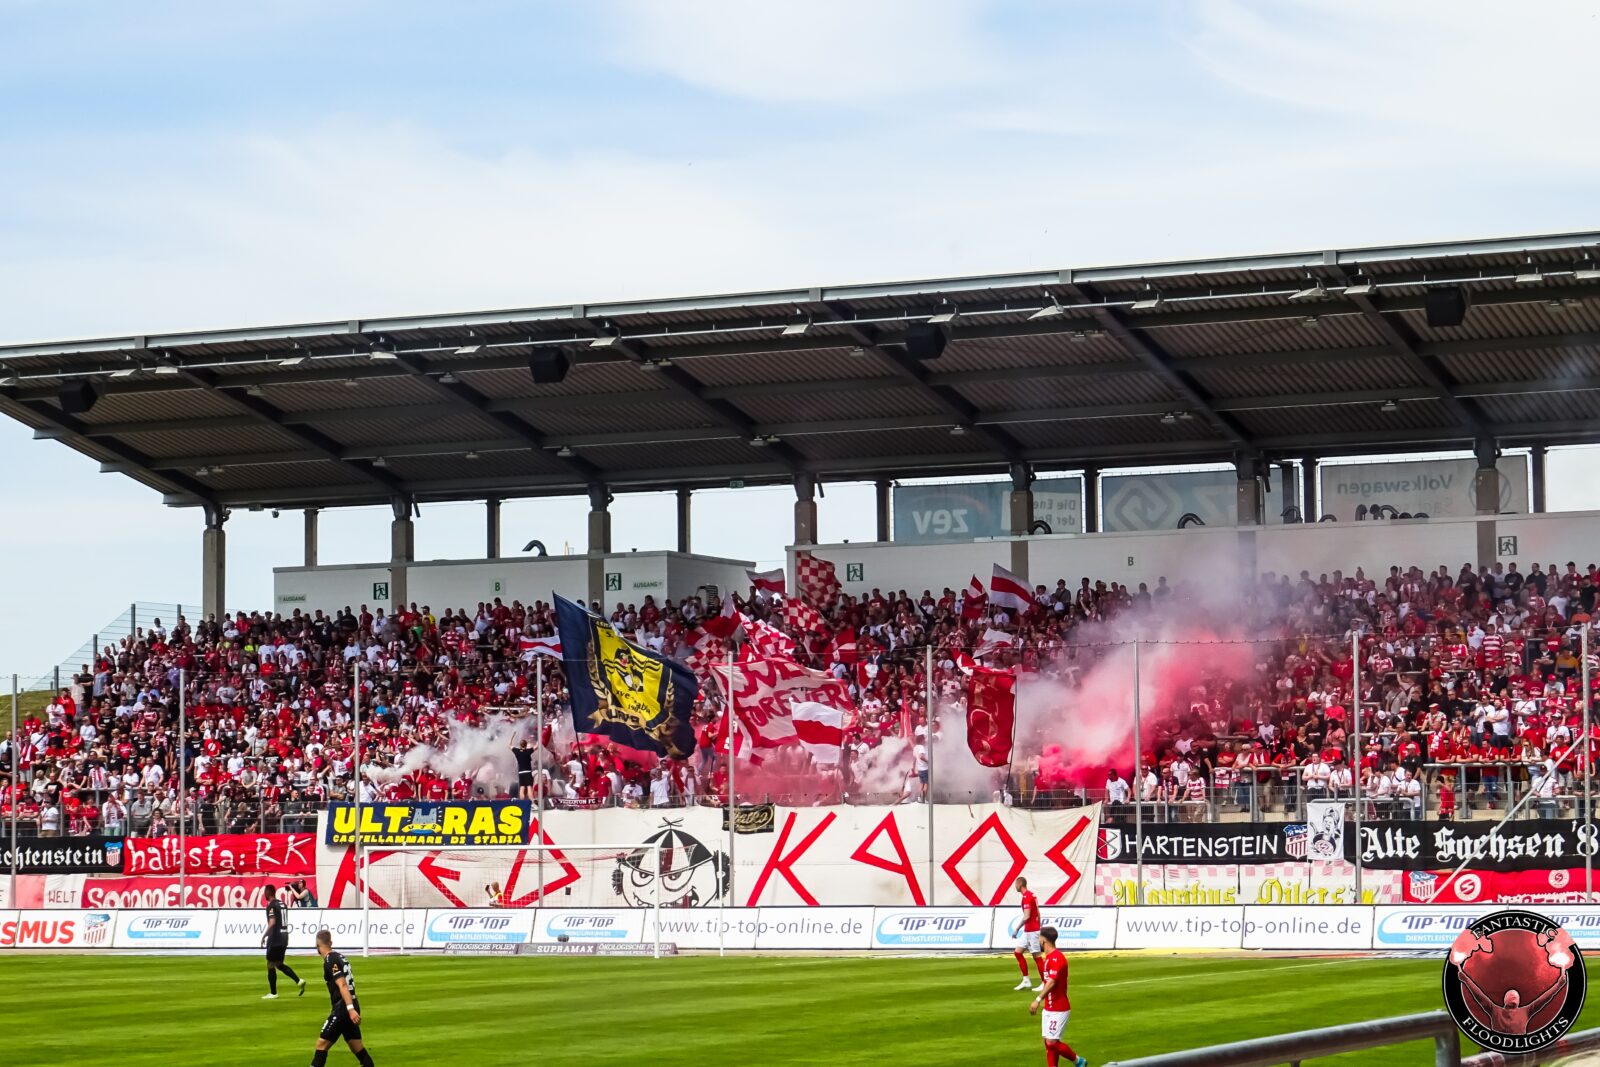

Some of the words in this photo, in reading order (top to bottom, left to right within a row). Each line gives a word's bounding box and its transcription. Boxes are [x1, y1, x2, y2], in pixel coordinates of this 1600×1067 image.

[1127, 556, 1135, 566] B
[494, 581, 501, 592] B
[333, 835, 442, 844] CASTELLAMMARE
[450, 835, 467, 844] DI
[474, 834, 522, 844] STABIA
[1359, 827, 1421, 862] Alte
[1434, 826, 1566, 862] Sachsen
[1125, 833, 1278, 857] HARTENSTEIN
[48, 890, 77, 903] WELT
[1126, 917, 1362, 939] www.tip-top-online.de
[536, 944, 595, 953] SUPRAMAX
[1049, 1020, 1057, 1031] 22
